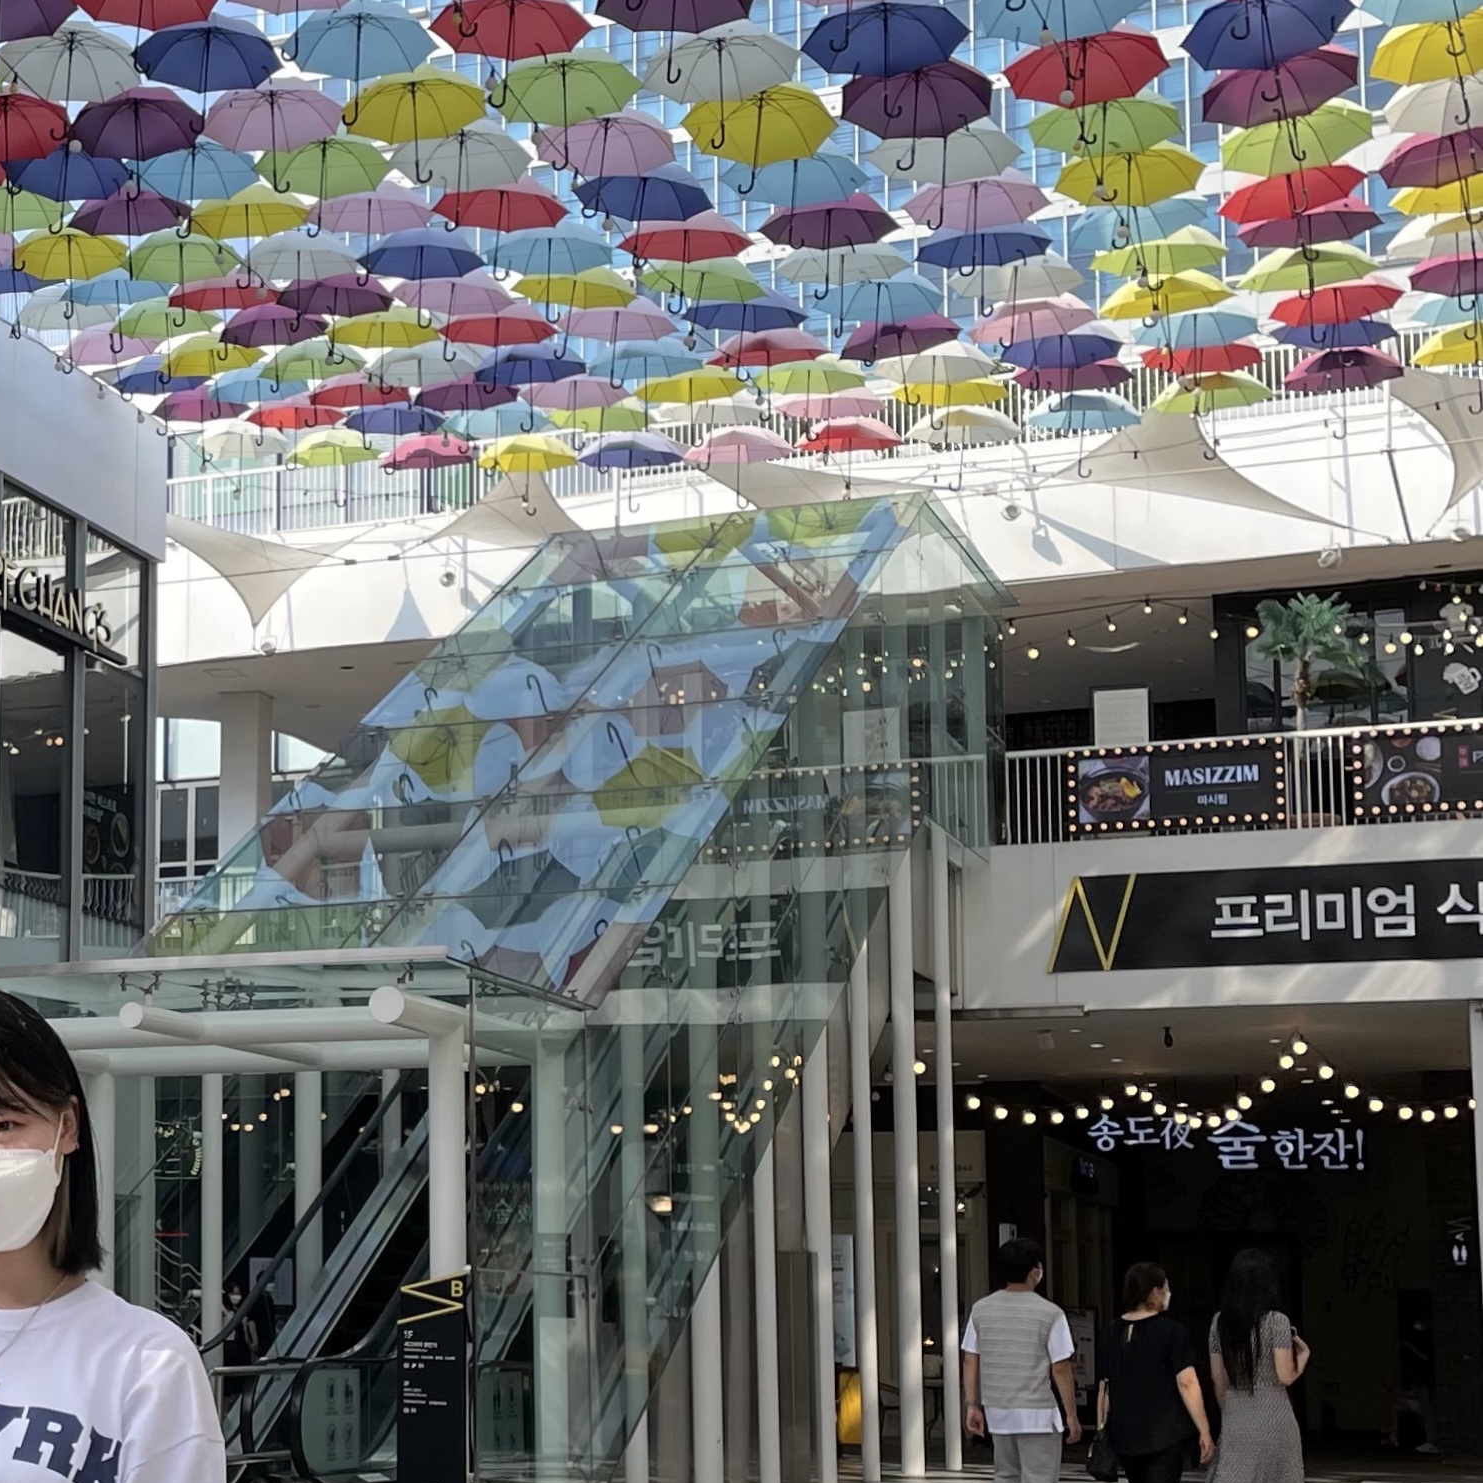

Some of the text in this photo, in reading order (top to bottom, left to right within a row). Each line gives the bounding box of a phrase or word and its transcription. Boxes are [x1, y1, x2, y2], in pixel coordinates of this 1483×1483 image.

[1164, 763, 1260, 787] MASIZZIM
[1211, 883, 1416, 941] 프리미엄
[450, 1280, 464, 1298] B
